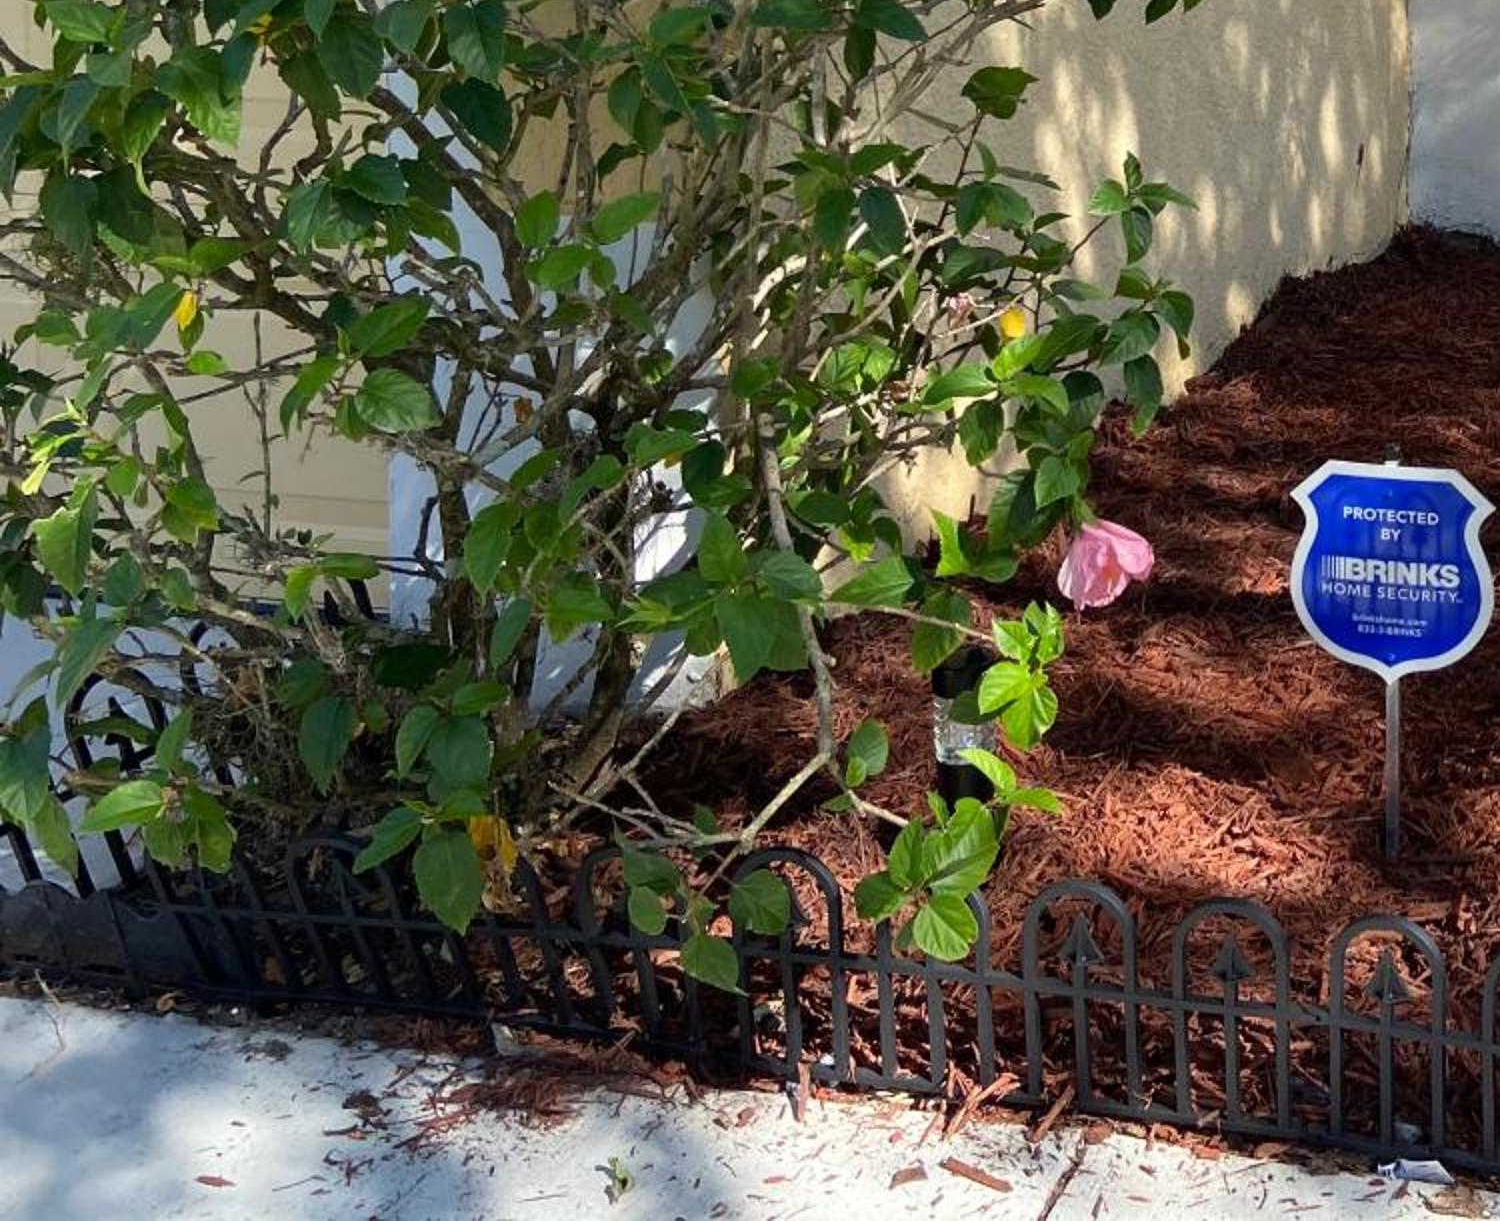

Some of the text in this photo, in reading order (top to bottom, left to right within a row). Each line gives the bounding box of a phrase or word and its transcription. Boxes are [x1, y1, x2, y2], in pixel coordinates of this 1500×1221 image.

[1343, 506, 1439, 525] PROTECTED
[1381, 529, 1400, 541] BY
[1344, 556, 1460, 588] BRINKS
[1321, 581, 1459, 604] HOME SECURITY
